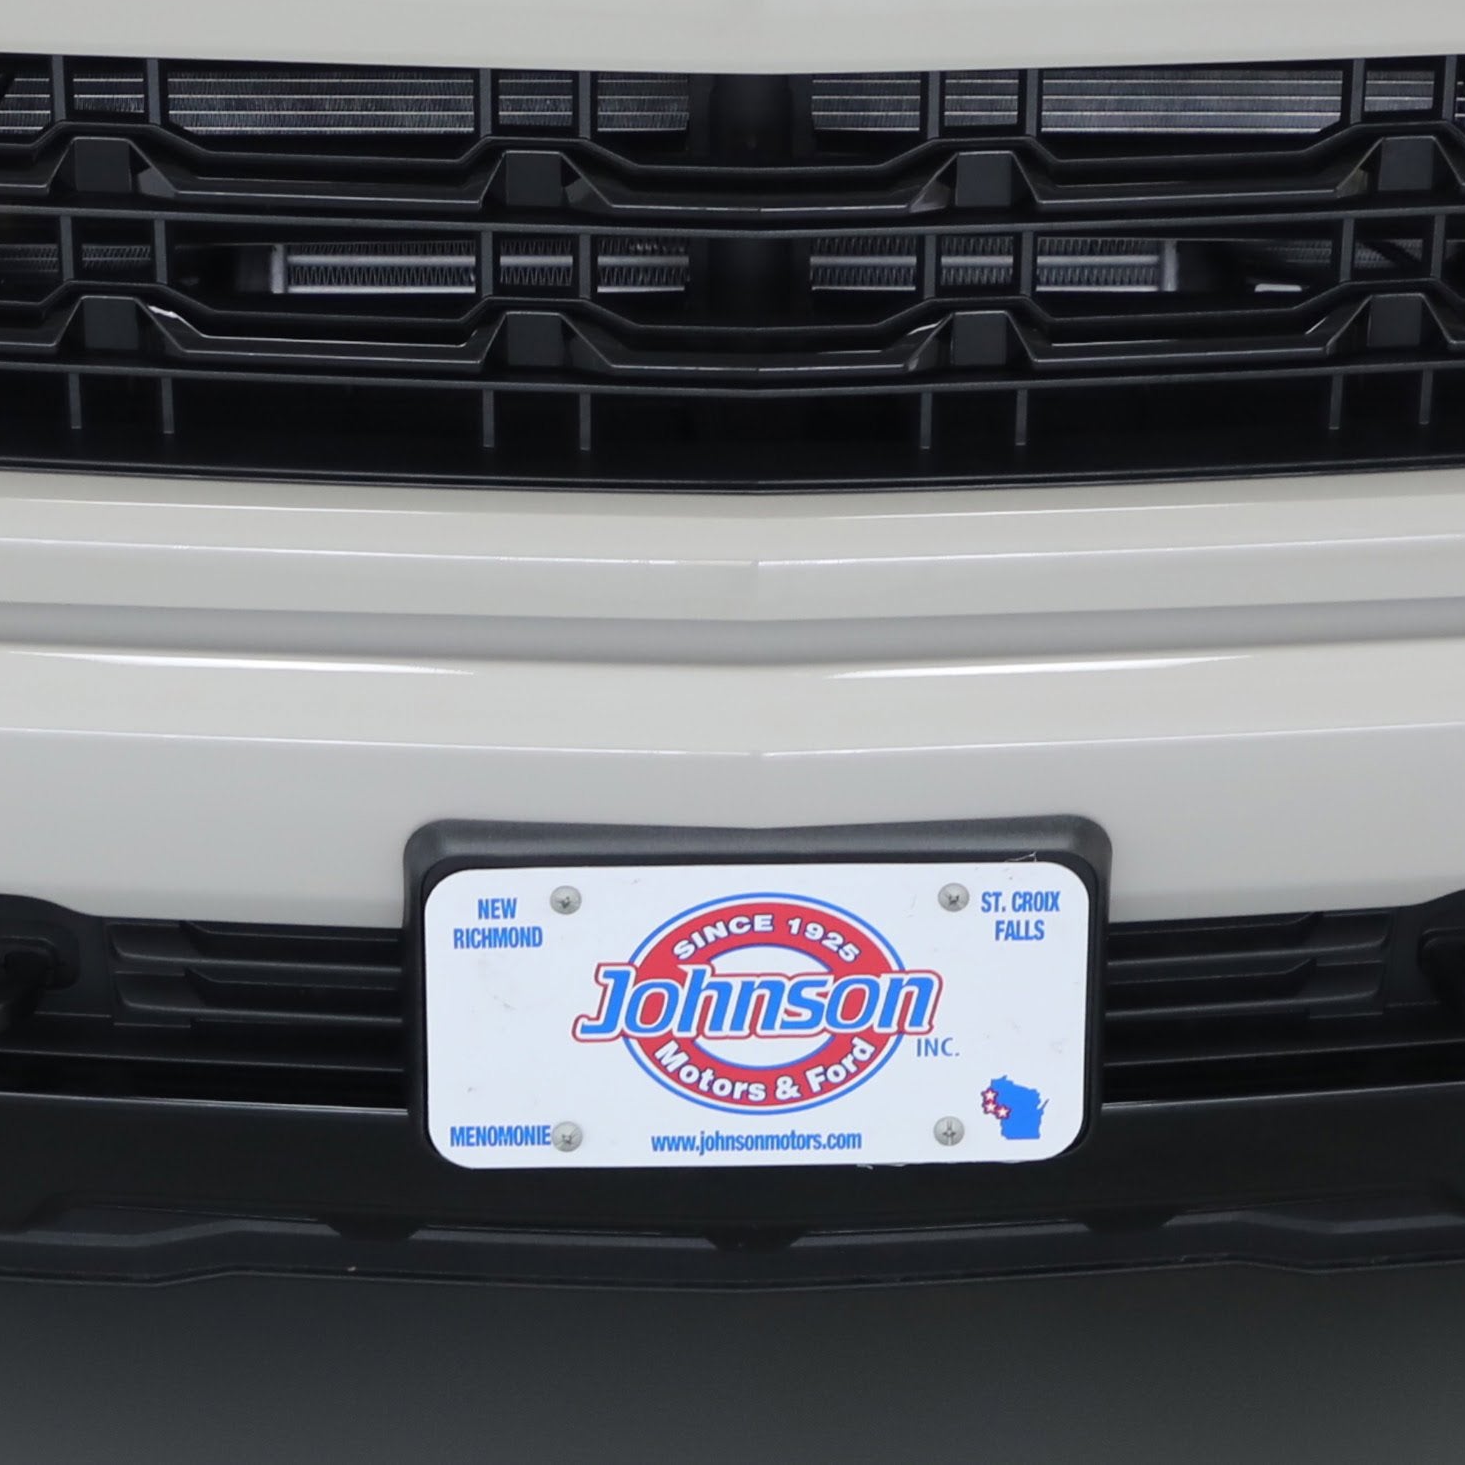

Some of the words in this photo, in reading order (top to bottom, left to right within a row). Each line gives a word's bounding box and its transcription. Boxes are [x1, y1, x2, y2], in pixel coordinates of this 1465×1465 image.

[477, 897, 518, 920] NEW
[980, 891, 1006, 913] ST.
[1011, 890, 1061, 913] CROIX
[453, 925, 543, 950] RICHMOND
[672, 913, 775, 961] SINCE
[787, 916, 861, 963] 1925
[994, 919, 1045, 941] FALLS
[575, 964, 938, 1038] Johnson
[915, 1036, 961, 1059] INC.
[654, 1040, 767, 1103] Motors
[775, 1075, 801, 1101] &
[805, 1036, 877, 1093] Ford
[449, 1124, 552, 1148] MENOMONIE
[650, 1131, 863, 1156] www.johnsonmotors.com
